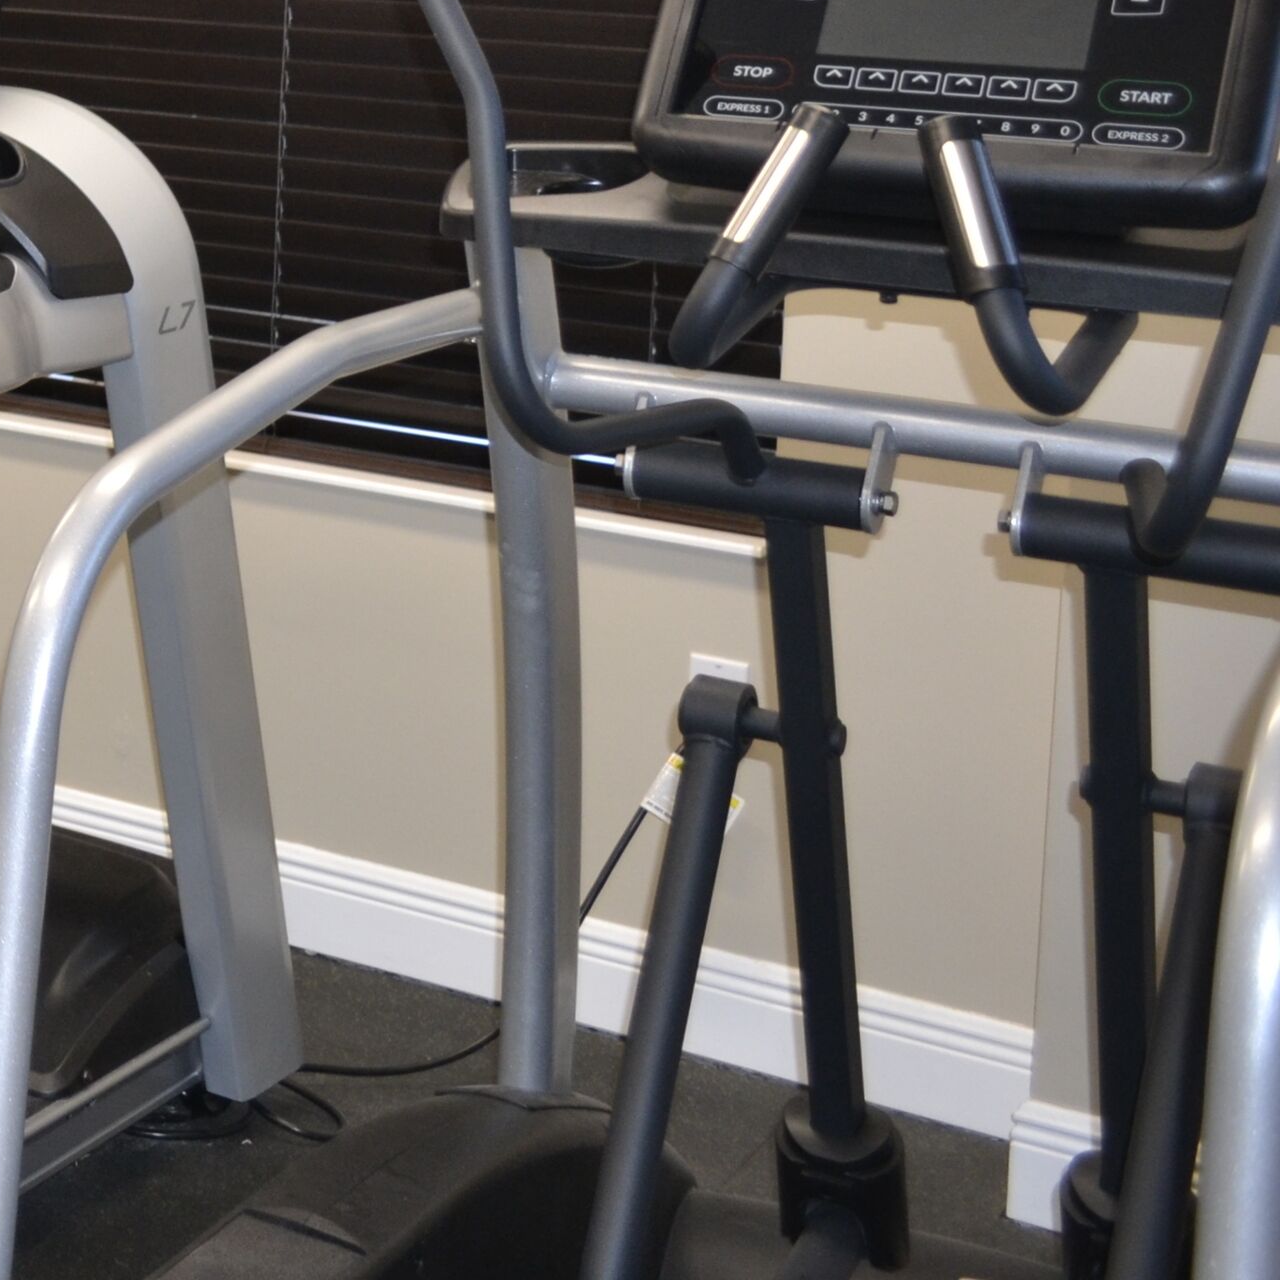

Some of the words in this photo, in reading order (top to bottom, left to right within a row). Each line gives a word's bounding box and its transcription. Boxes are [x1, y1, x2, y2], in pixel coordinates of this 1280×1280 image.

[733, 65, 774, 78] STOP
[1119, 90, 1174, 105] START
[717, 101, 762, 113] EXPRESS
[763, 105, 771, 114] 1
[858, 111, 868, 122] 3
[886, 113, 895, 123] 4
[914, 115, 924, 126] 5
[1001, 121, 1011, 132] 8
[1031, 123, 1041, 134] 9
[1060, 125, 1070, 137] 0
[1107, 129, 1159, 142] EXPRESS
[1161, 133, 1171, 144] 2
[158, 299, 196, 335] L7
